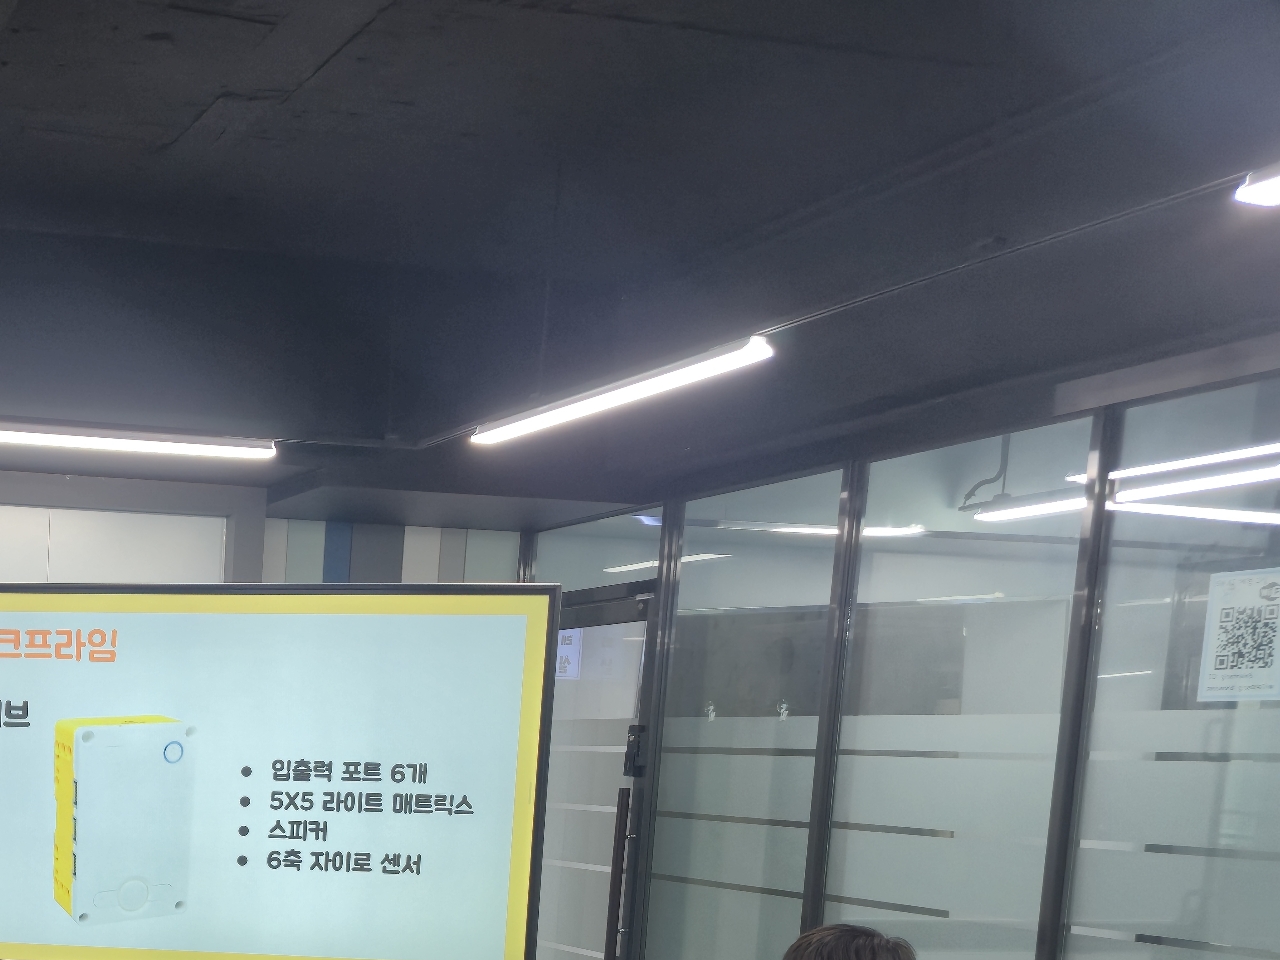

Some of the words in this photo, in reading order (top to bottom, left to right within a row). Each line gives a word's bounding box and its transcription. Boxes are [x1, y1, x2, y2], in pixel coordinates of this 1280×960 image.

[271, 759, 333, 783] 입출력
[341, 761, 382, 782] 포트
[390, 763, 428, 784] 6개
[269, 791, 314, 811] 5X5
[322, 791, 384, 813] 라이트
[392, 793, 474, 816] 매트릭스
[268, 820, 328, 842] 스피커
[266, 849, 303, 872] 6축
[310, 851, 373, 873] 자이로
[380, 853, 422, 876] 센서
